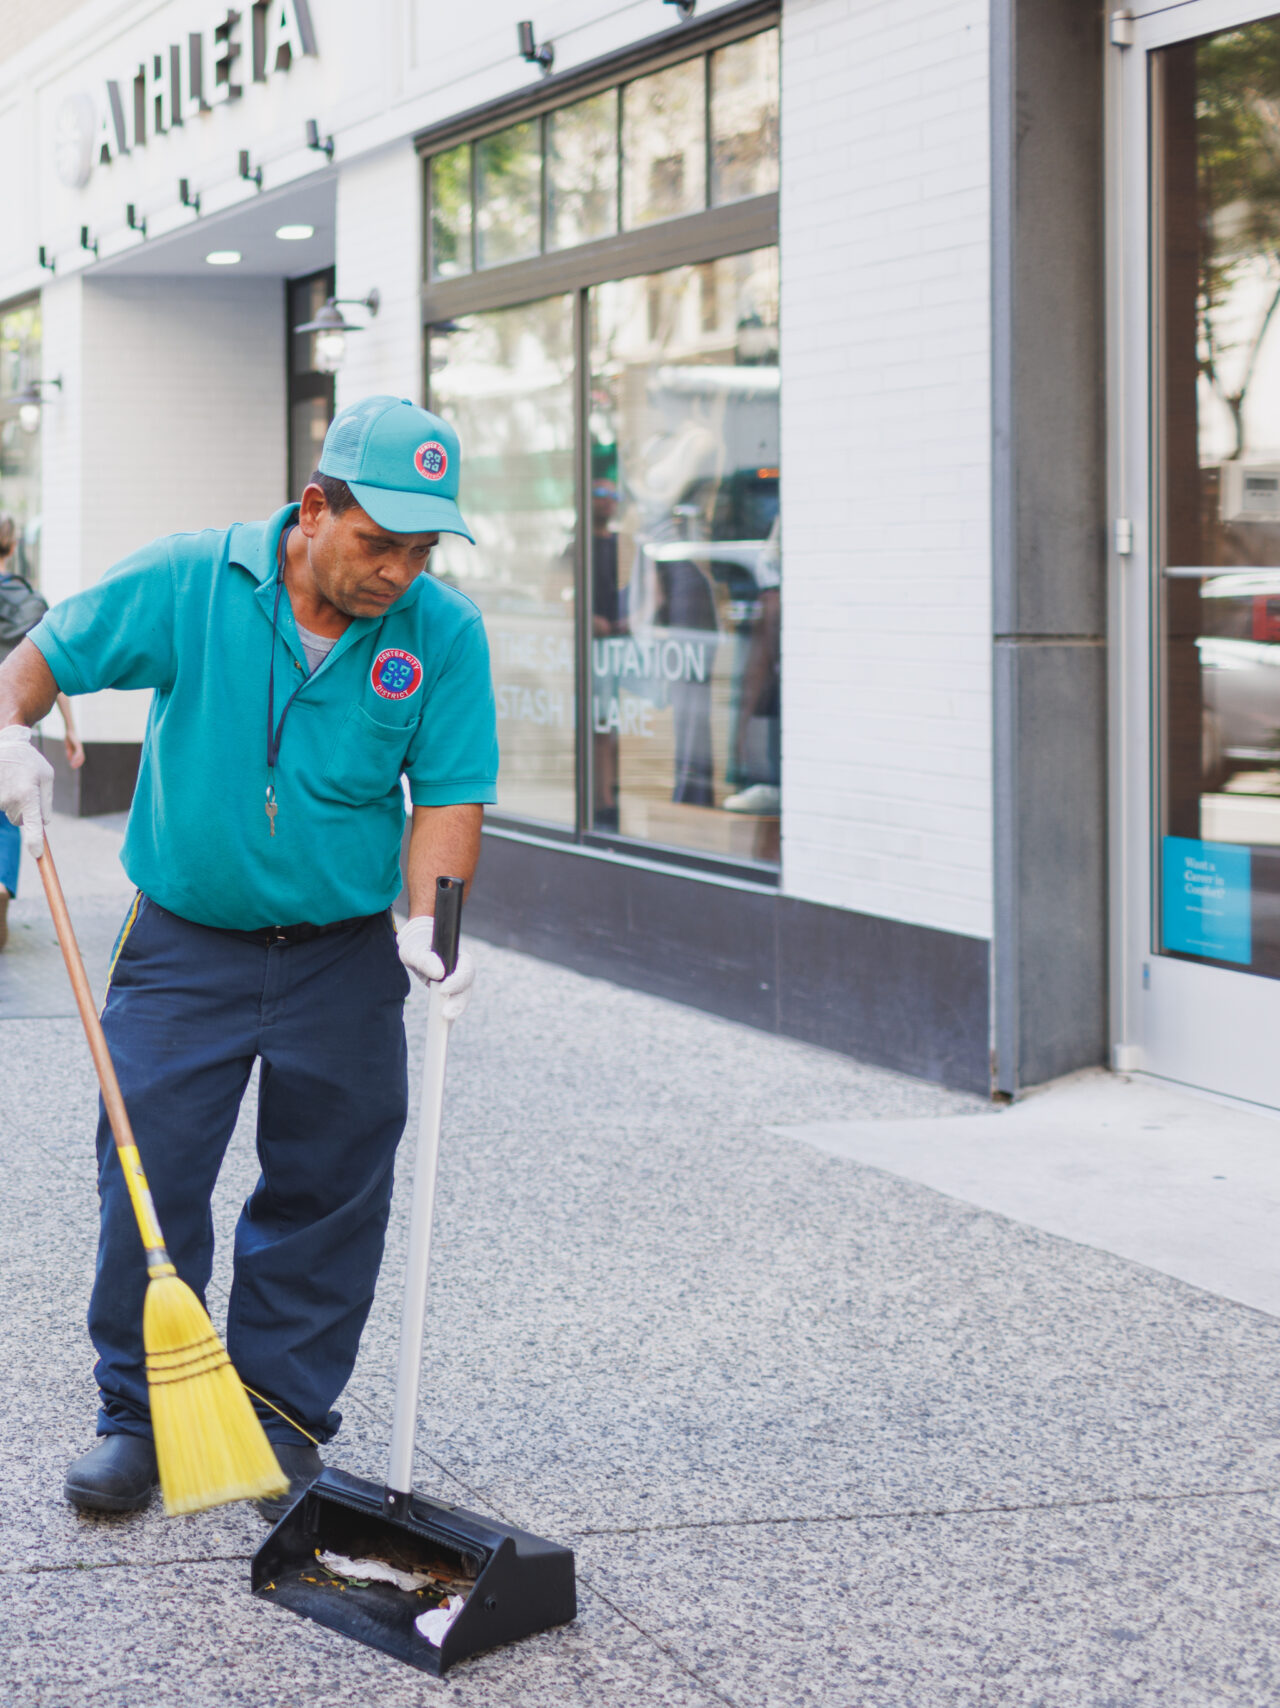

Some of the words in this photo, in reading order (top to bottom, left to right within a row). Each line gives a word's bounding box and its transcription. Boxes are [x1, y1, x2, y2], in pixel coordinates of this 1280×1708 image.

[93, 0, 320, 165] ATHLETA
[379, 651, 405, 663] CENTER
[406, 656, 420, 669] CITY
[496, 632, 537, 669] THE
[543, 634, 706, 683] SAUTATION
[376, 685, 408, 698] DISTRICT
[497, 684, 564, 728] STASH
